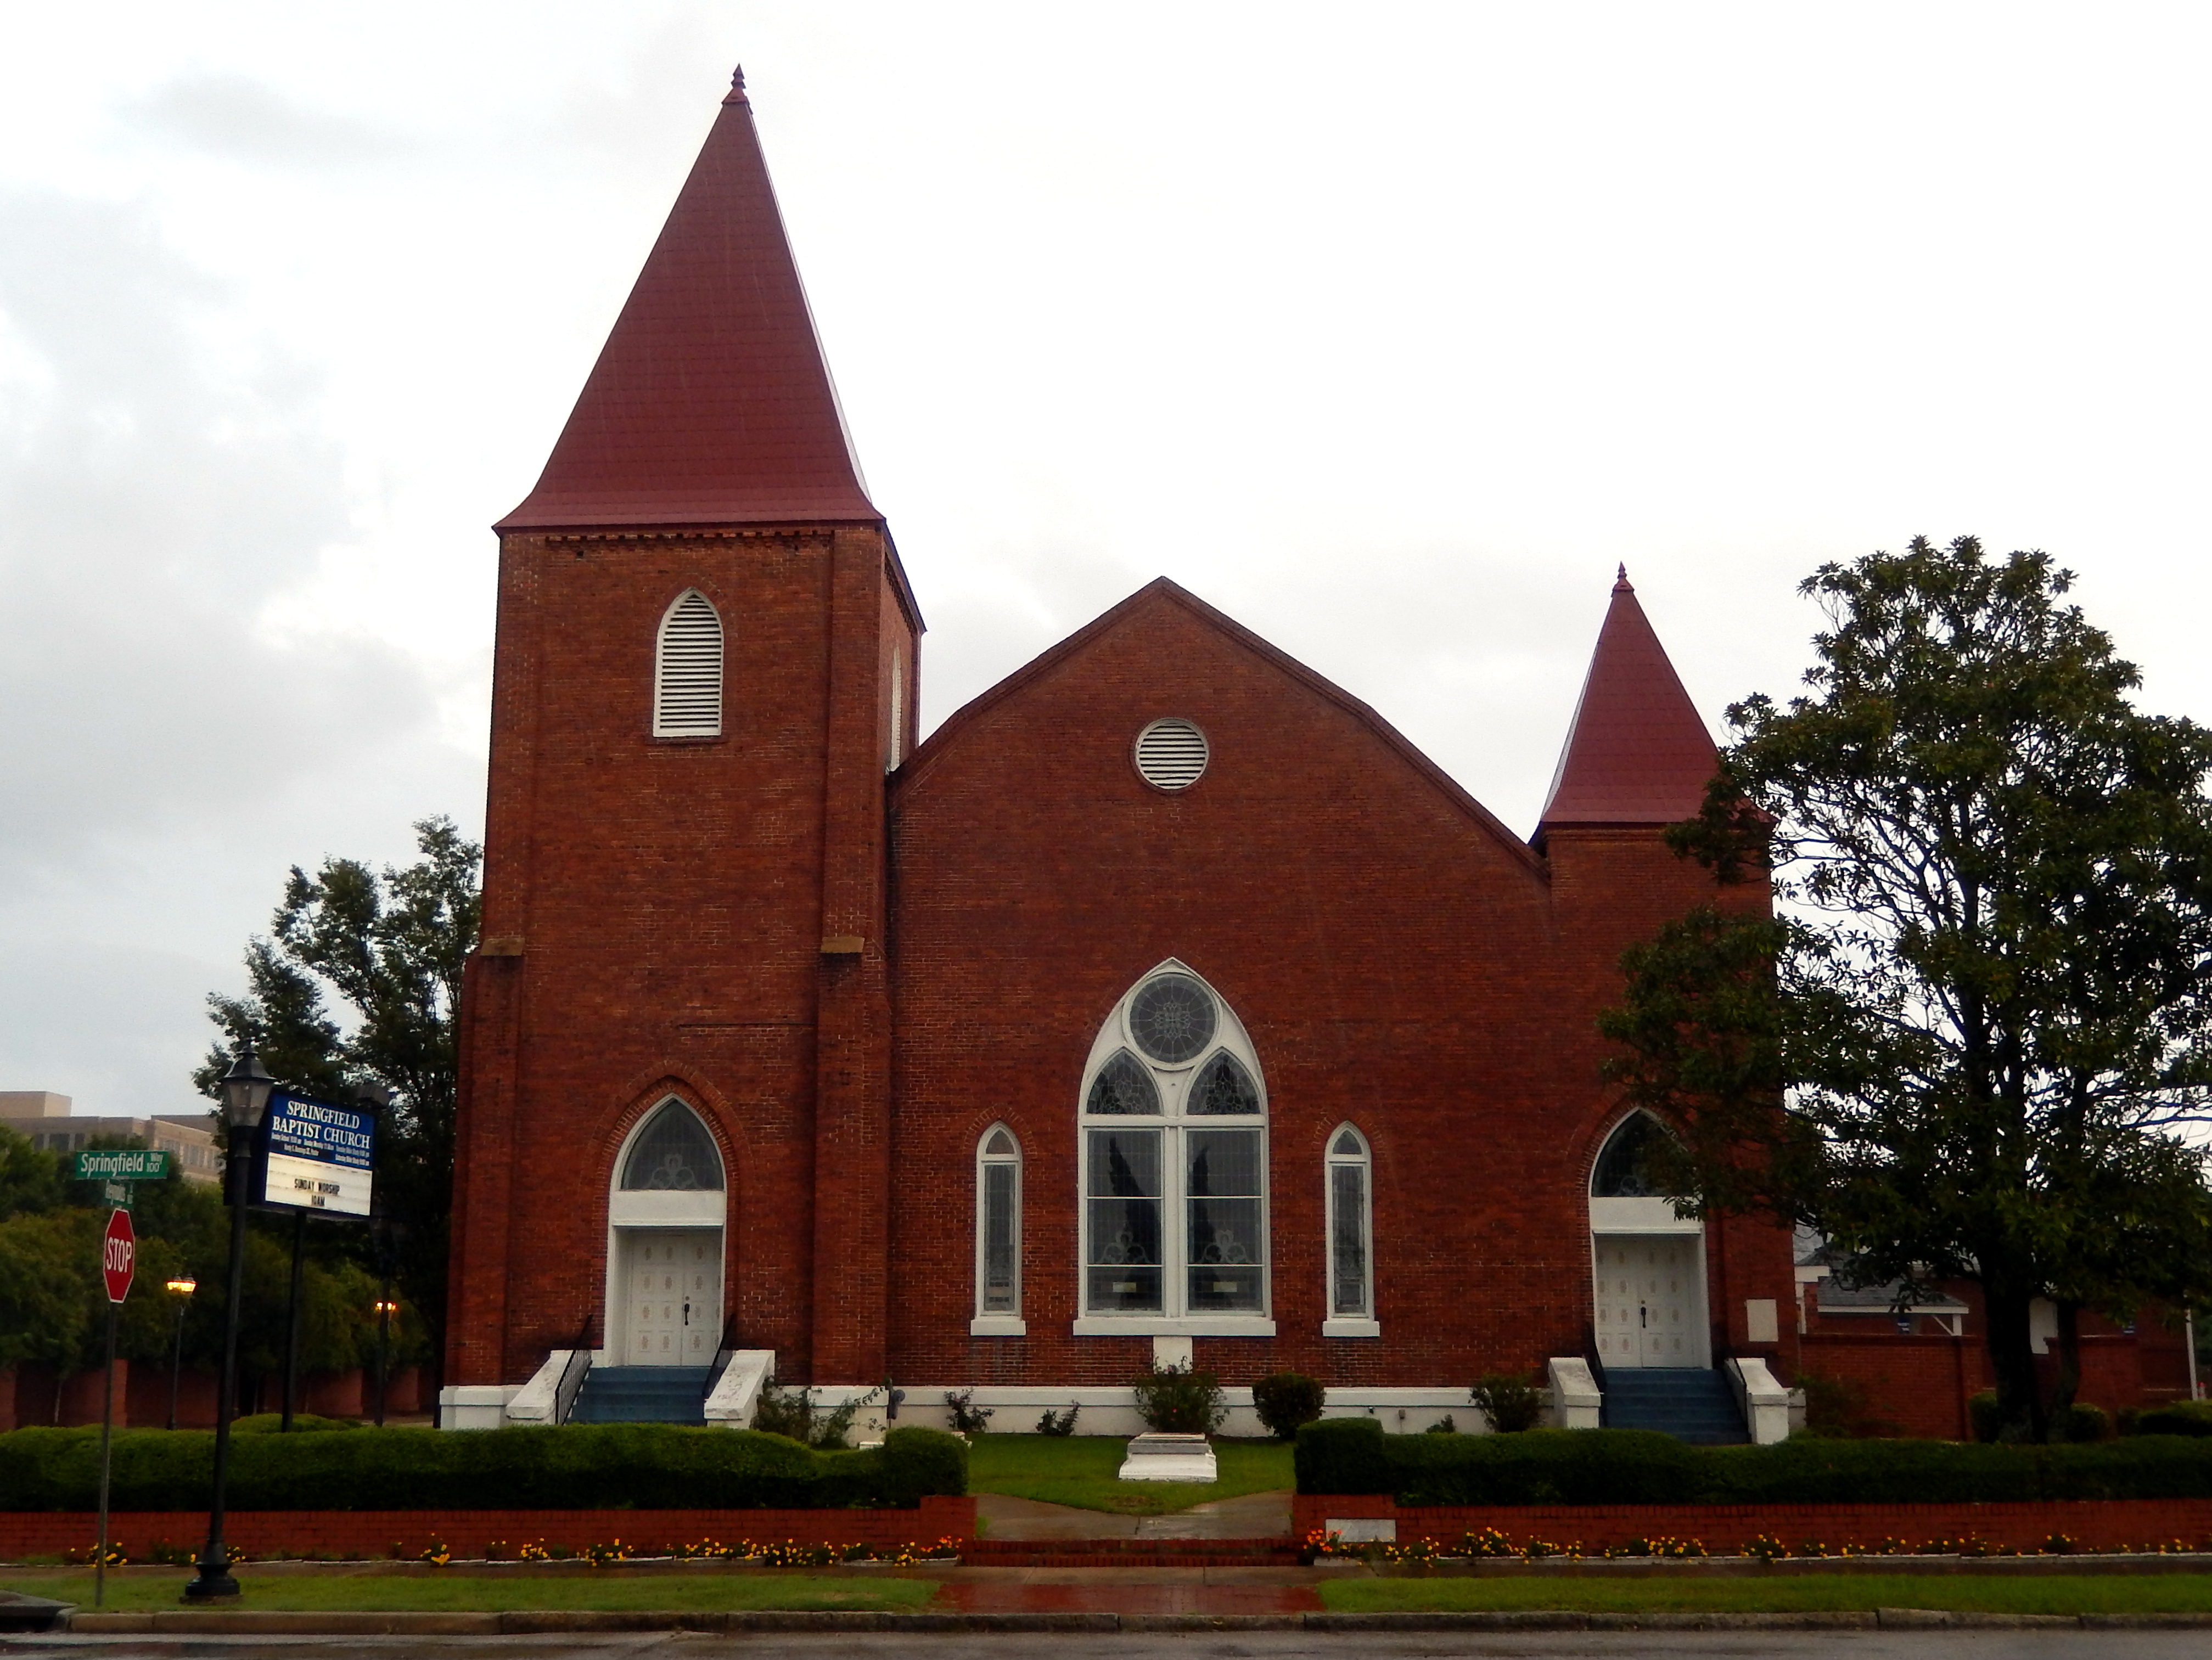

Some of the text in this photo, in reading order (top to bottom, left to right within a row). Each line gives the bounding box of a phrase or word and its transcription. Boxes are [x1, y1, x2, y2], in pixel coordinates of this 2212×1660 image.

[287, 1100, 360, 1129] SPRINGFIELD
[272, 1116, 322, 1139] BAPTIST
[323, 1127, 370, 1149] CHURCH
[81, 1153, 144, 1177] Springfield
[147, 1162, 160, 1172] 100
[294, 1178, 315, 1191] SUNDAY
[106, 1236, 132, 1273] STOP
